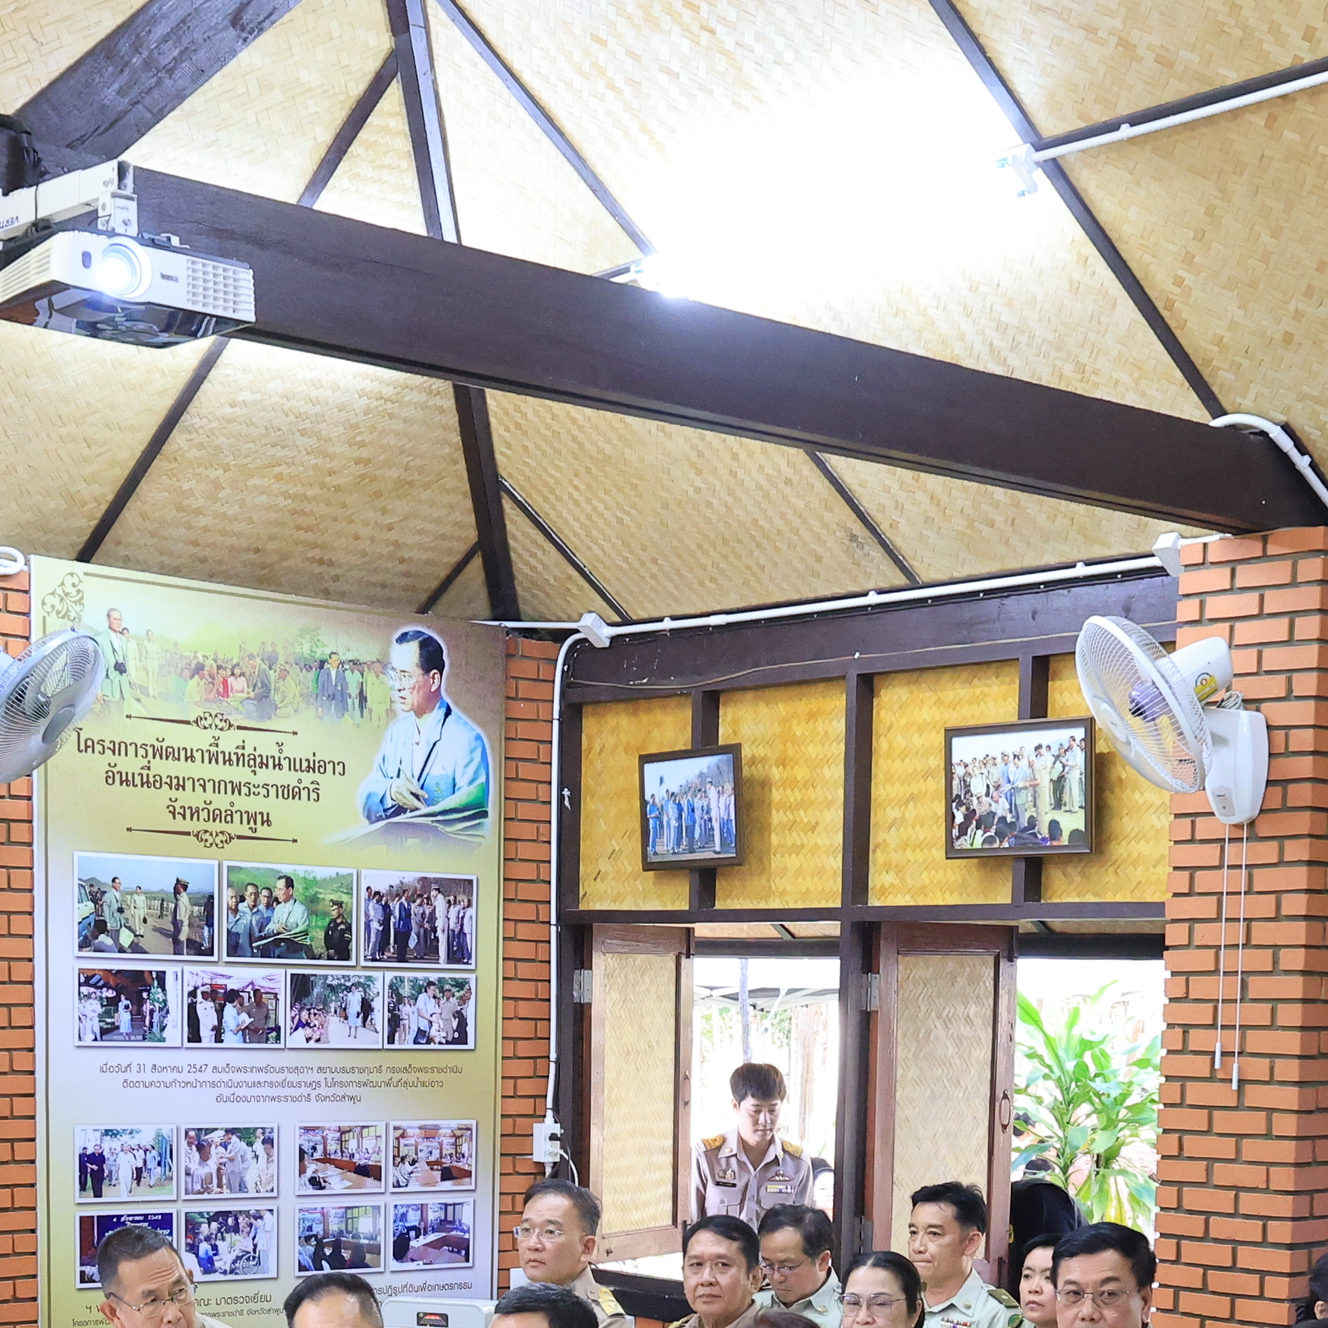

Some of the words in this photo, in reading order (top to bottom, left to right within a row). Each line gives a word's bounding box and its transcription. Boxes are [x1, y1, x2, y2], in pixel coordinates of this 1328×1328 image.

[74, 727, 347, 777] โครงการพัฒนาพื้นที่ลุ่มน้ำแม่อาว
[104, 760, 321, 802] อันเนื่องมาจากพระราชดำริ
[166, 797, 272, 834] จังหวัดลำพูน
[99, 1061, 132, 1074] เมื่อวันที่
[136, 1063, 146, 1074] 31
[150, 1063, 183, 1074] สิงหาคม
[187, 1063, 208, 1074] 2547
[315, 1092, 362, 1105] จังหวัดลำพูน
[373, 1280, 472, 1297] ารปฏิรูปที่ดินเพื่อเกษตรกรรม
[215, 1291, 272, 1306] มาตรวจเยี่ยม
